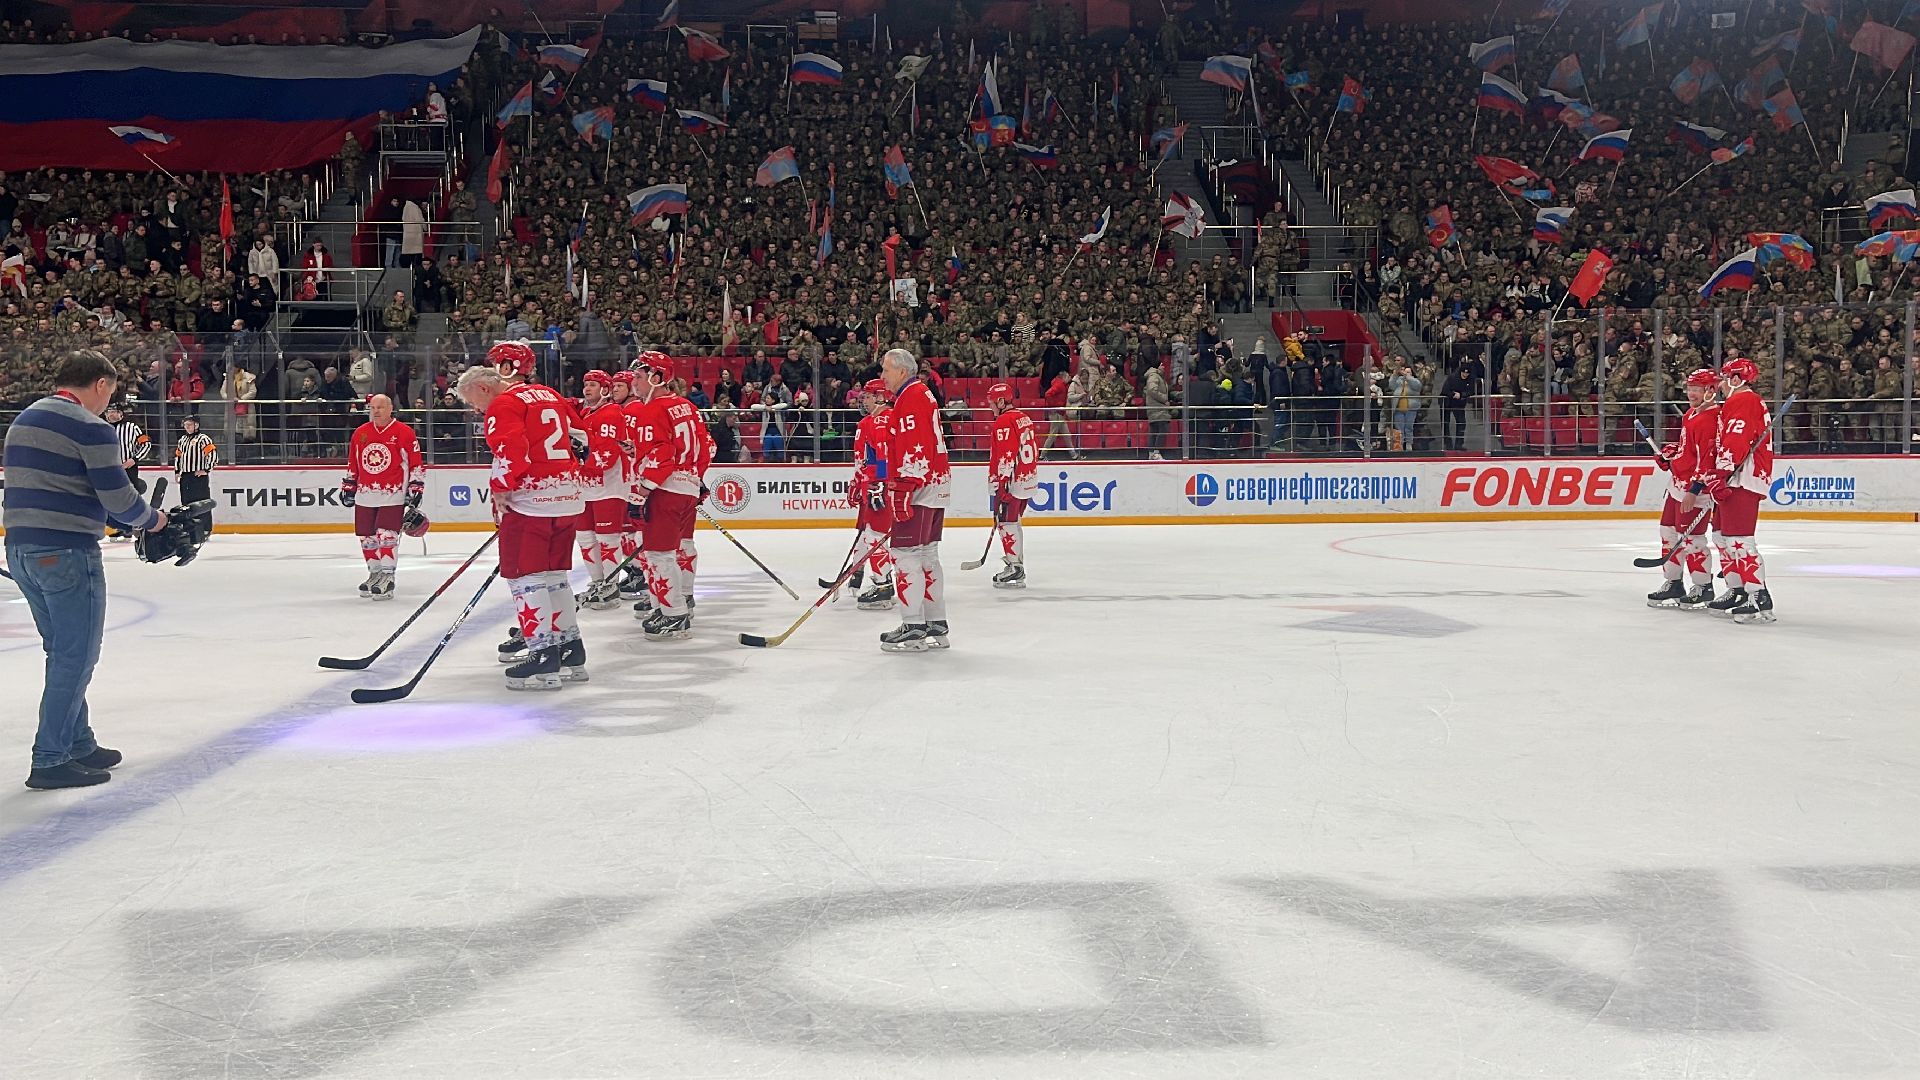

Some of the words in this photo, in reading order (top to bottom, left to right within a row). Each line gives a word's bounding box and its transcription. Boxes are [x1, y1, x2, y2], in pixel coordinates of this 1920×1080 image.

[487, 416, 496, 435] 2
[600, 423, 616, 438] 95
[900, 415, 915, 433] 15
[1726, 418, 1745, 434] 72
[541, 408, 570, 460] 2
[637, 425, 653, 442] 76
[997, 427, 1010, 441] 67
[757, 481, 827, 494] БИЛЕТЫ
[990, 471, 1118, 512] aier
[1225, 472, 1417, 505] севернефтегазпром
[1440, 466, 1655, 507] FONBET
[1797, 477, 1855, 490] ГАЗПРОМ
[222, 487, 340, 508] ТИНЬК
